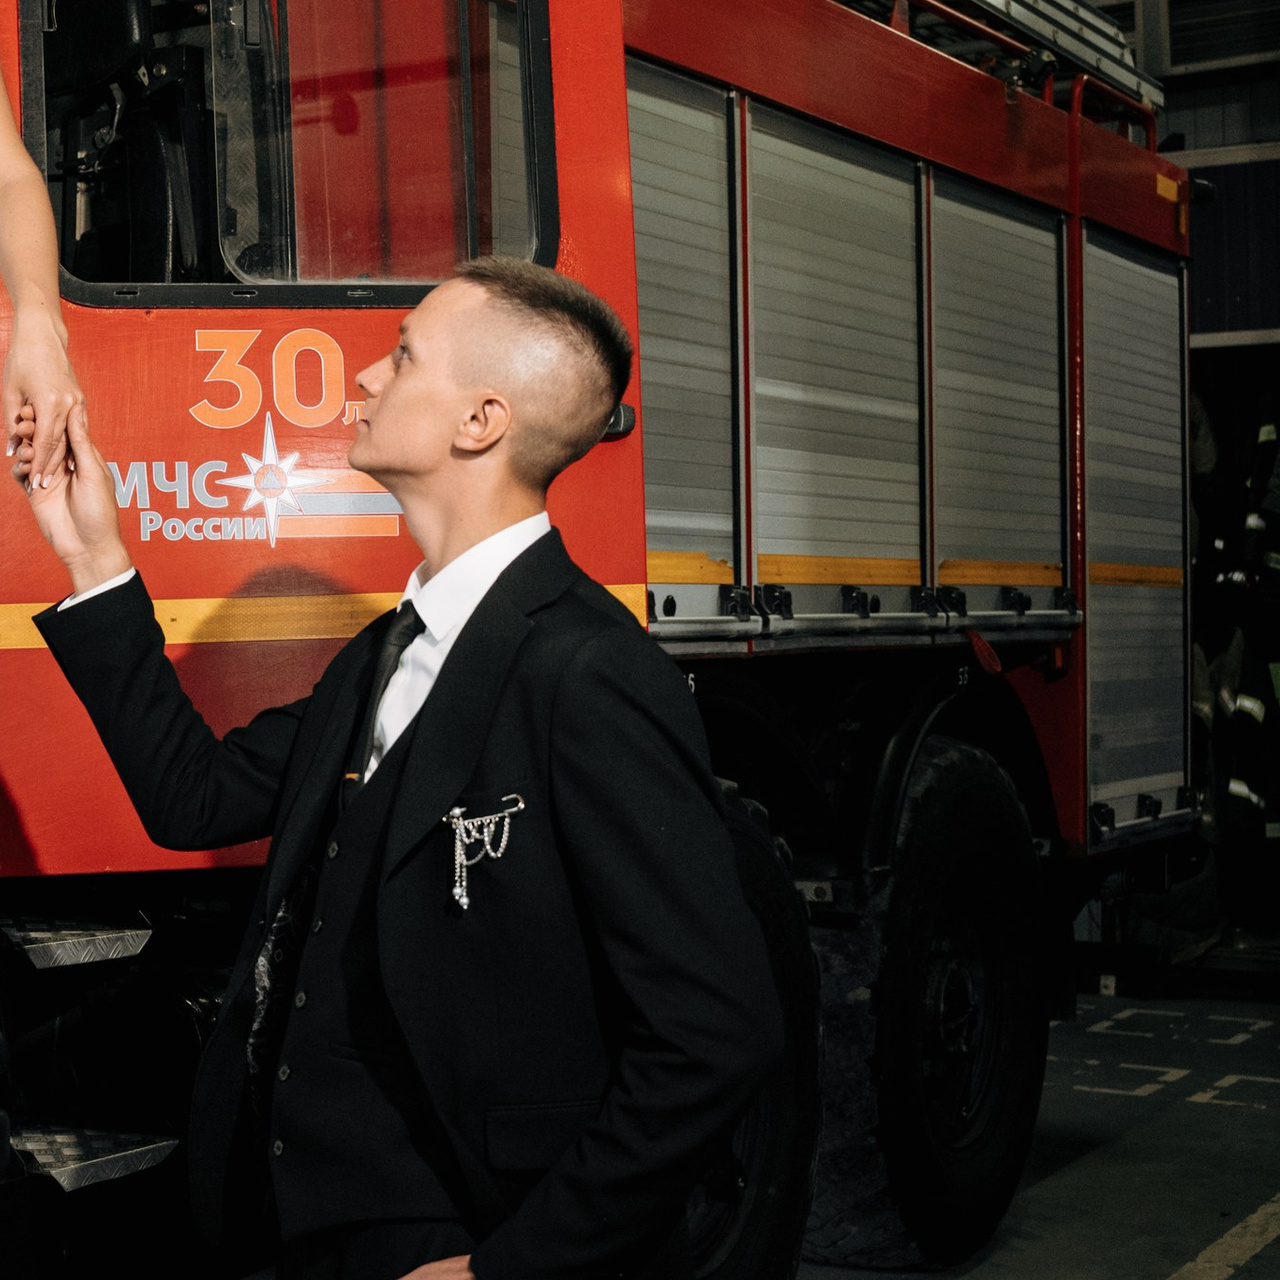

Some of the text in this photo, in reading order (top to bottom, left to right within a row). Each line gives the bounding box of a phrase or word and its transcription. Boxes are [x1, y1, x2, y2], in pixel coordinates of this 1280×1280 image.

[189, 328, 345, 428] 30
[106, 460, 229, 509] МЧС
[140, 511, 268, 542] России
